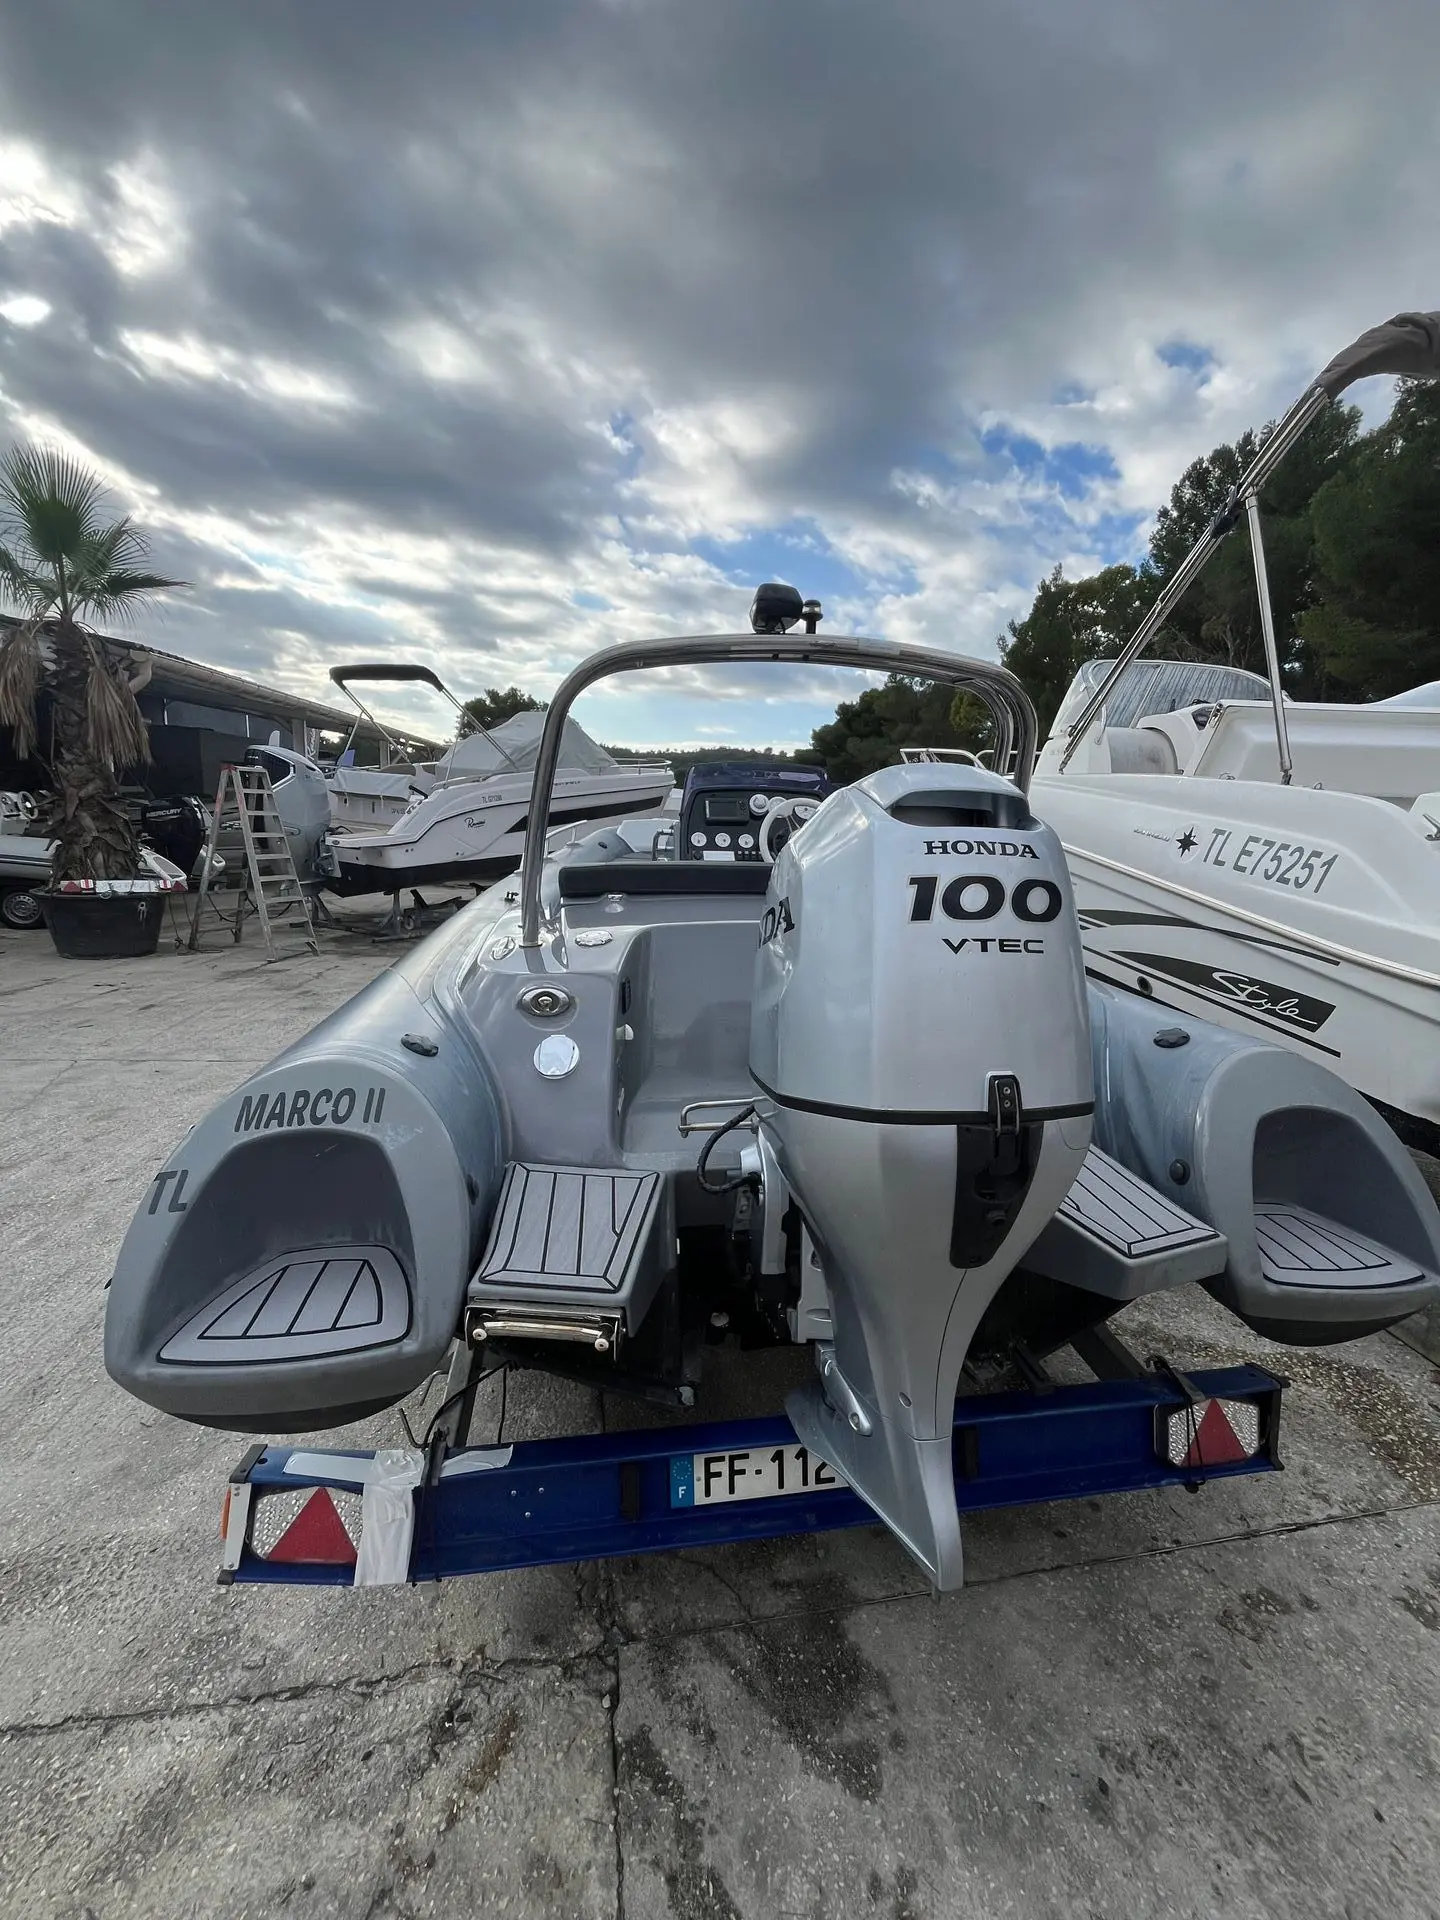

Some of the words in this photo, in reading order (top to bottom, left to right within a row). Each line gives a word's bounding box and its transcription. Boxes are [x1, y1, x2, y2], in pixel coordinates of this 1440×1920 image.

[146, 808, 182, 818] MERCURY
[923, 840, 1040, 860] HONDA
[1203, 828, 1232, 867] TL
[1232, 835, 1340, 893] E75251
[907, 875, 1063, 923] 100
[942, 938, 1044, 954] VTEC
[1199, 971, 1318, 1025] Style
[234, 1088, 356, 1133] MARCO
[362, 1087, 386, 1124] II
[148, 1169, 189, 1215] TL
[678, 1486, 687, 1499] F
